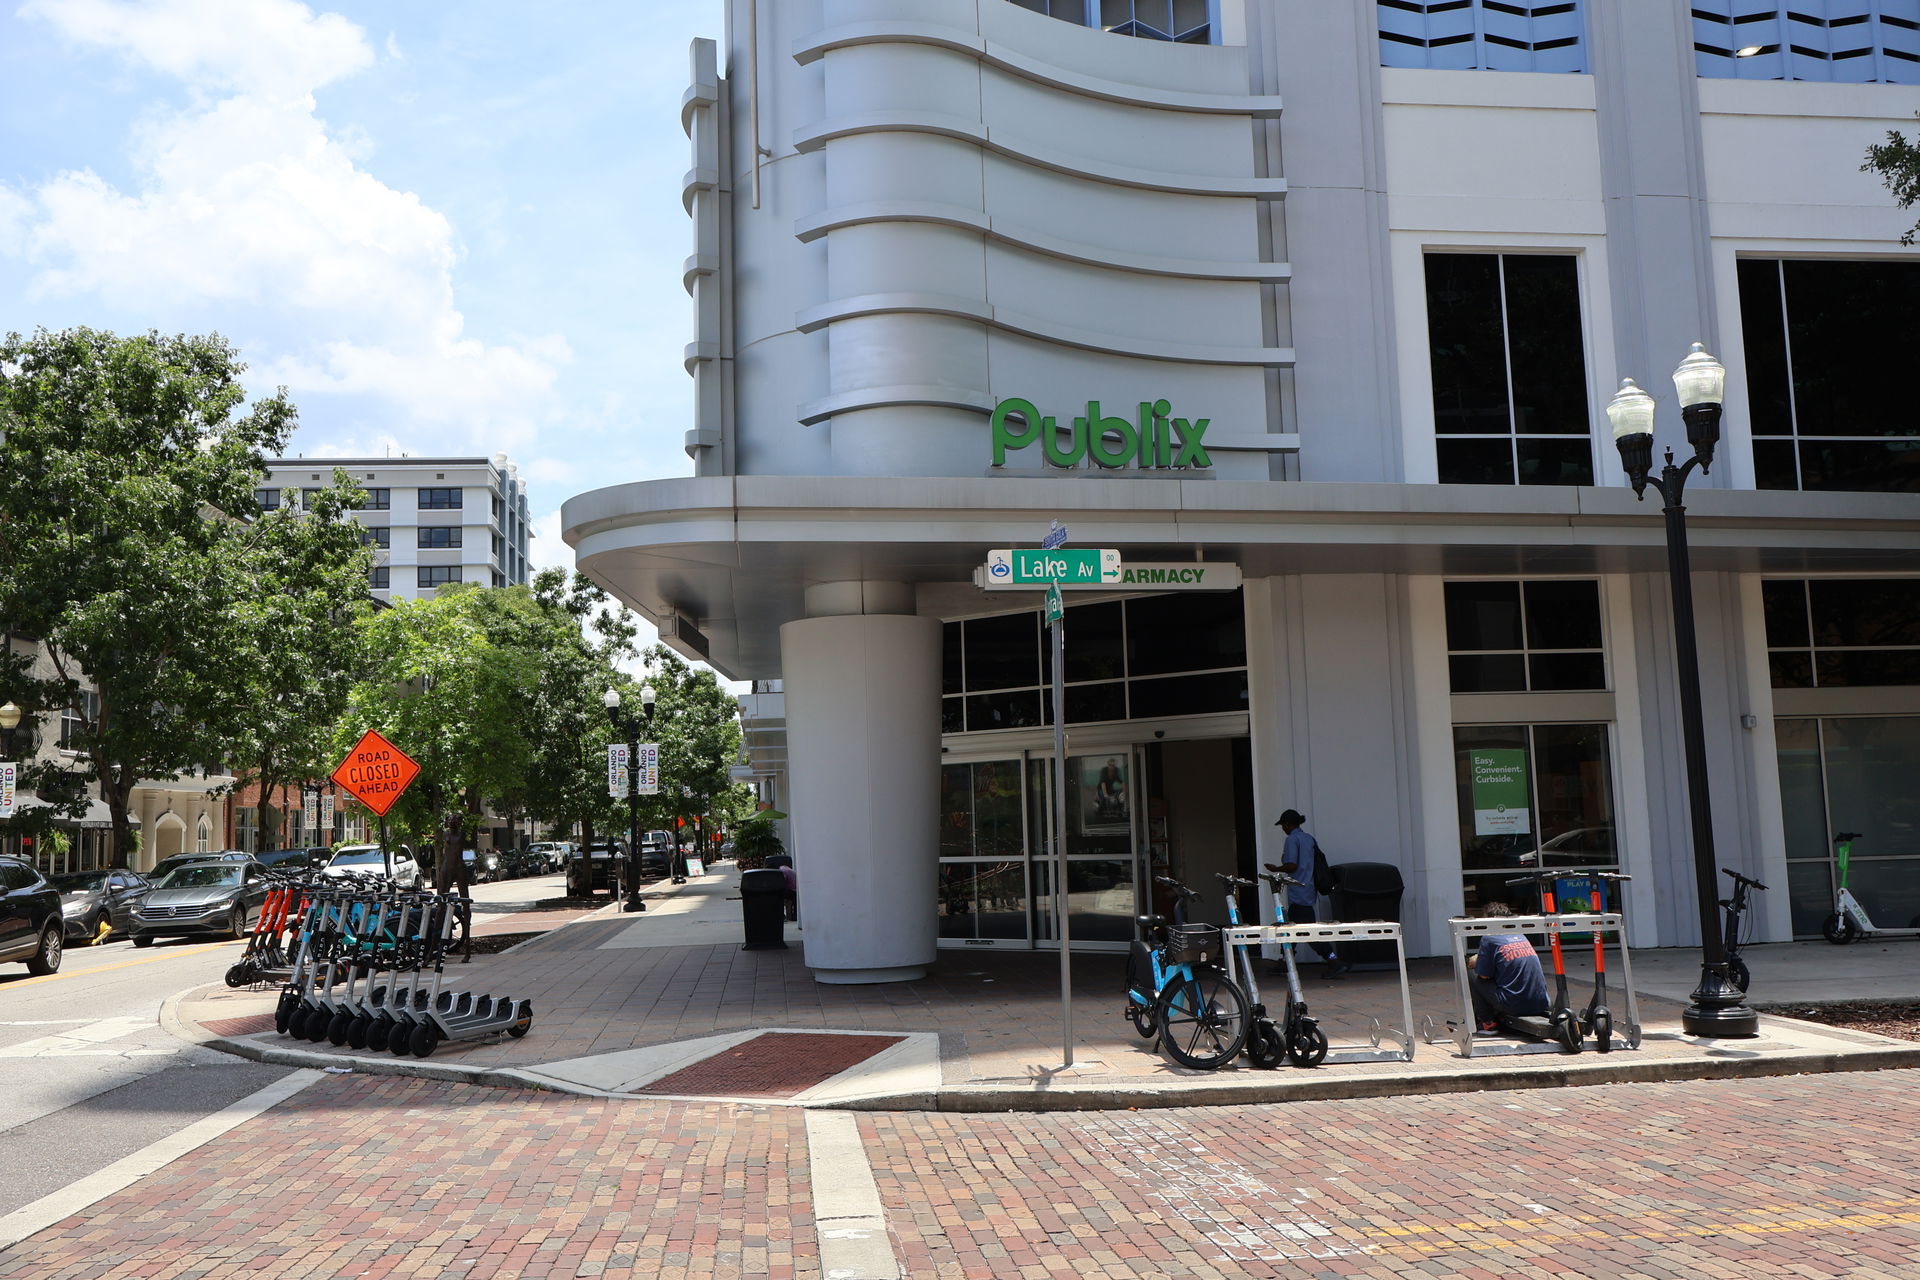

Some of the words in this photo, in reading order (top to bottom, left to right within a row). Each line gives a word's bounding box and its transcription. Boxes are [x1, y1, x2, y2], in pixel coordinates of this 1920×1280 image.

[992, 397, 1213, 469] Publix
[1020, 555, 1068, 578] Lake
[1077, 561, 1094, 577] Av
[1121, 568, 1205, 584] ARMACY
[357, 750, 390, 763] ROAD
[1474, 756, 1495, 766] Easy.
[350, 763, 399, 783] CLOSED
[618, 749, 626, 784] NITED
[648, 749, 656, 785] UNITED
[1475, 765, 1523, 774] Convenient.
[4, 767, 14, 806] UNITED
[1475, 774, 1514, 784] Curbside.
[358, 781, 398, 795] AHEAD
[1566, 880, 1584, 888] PLAY
